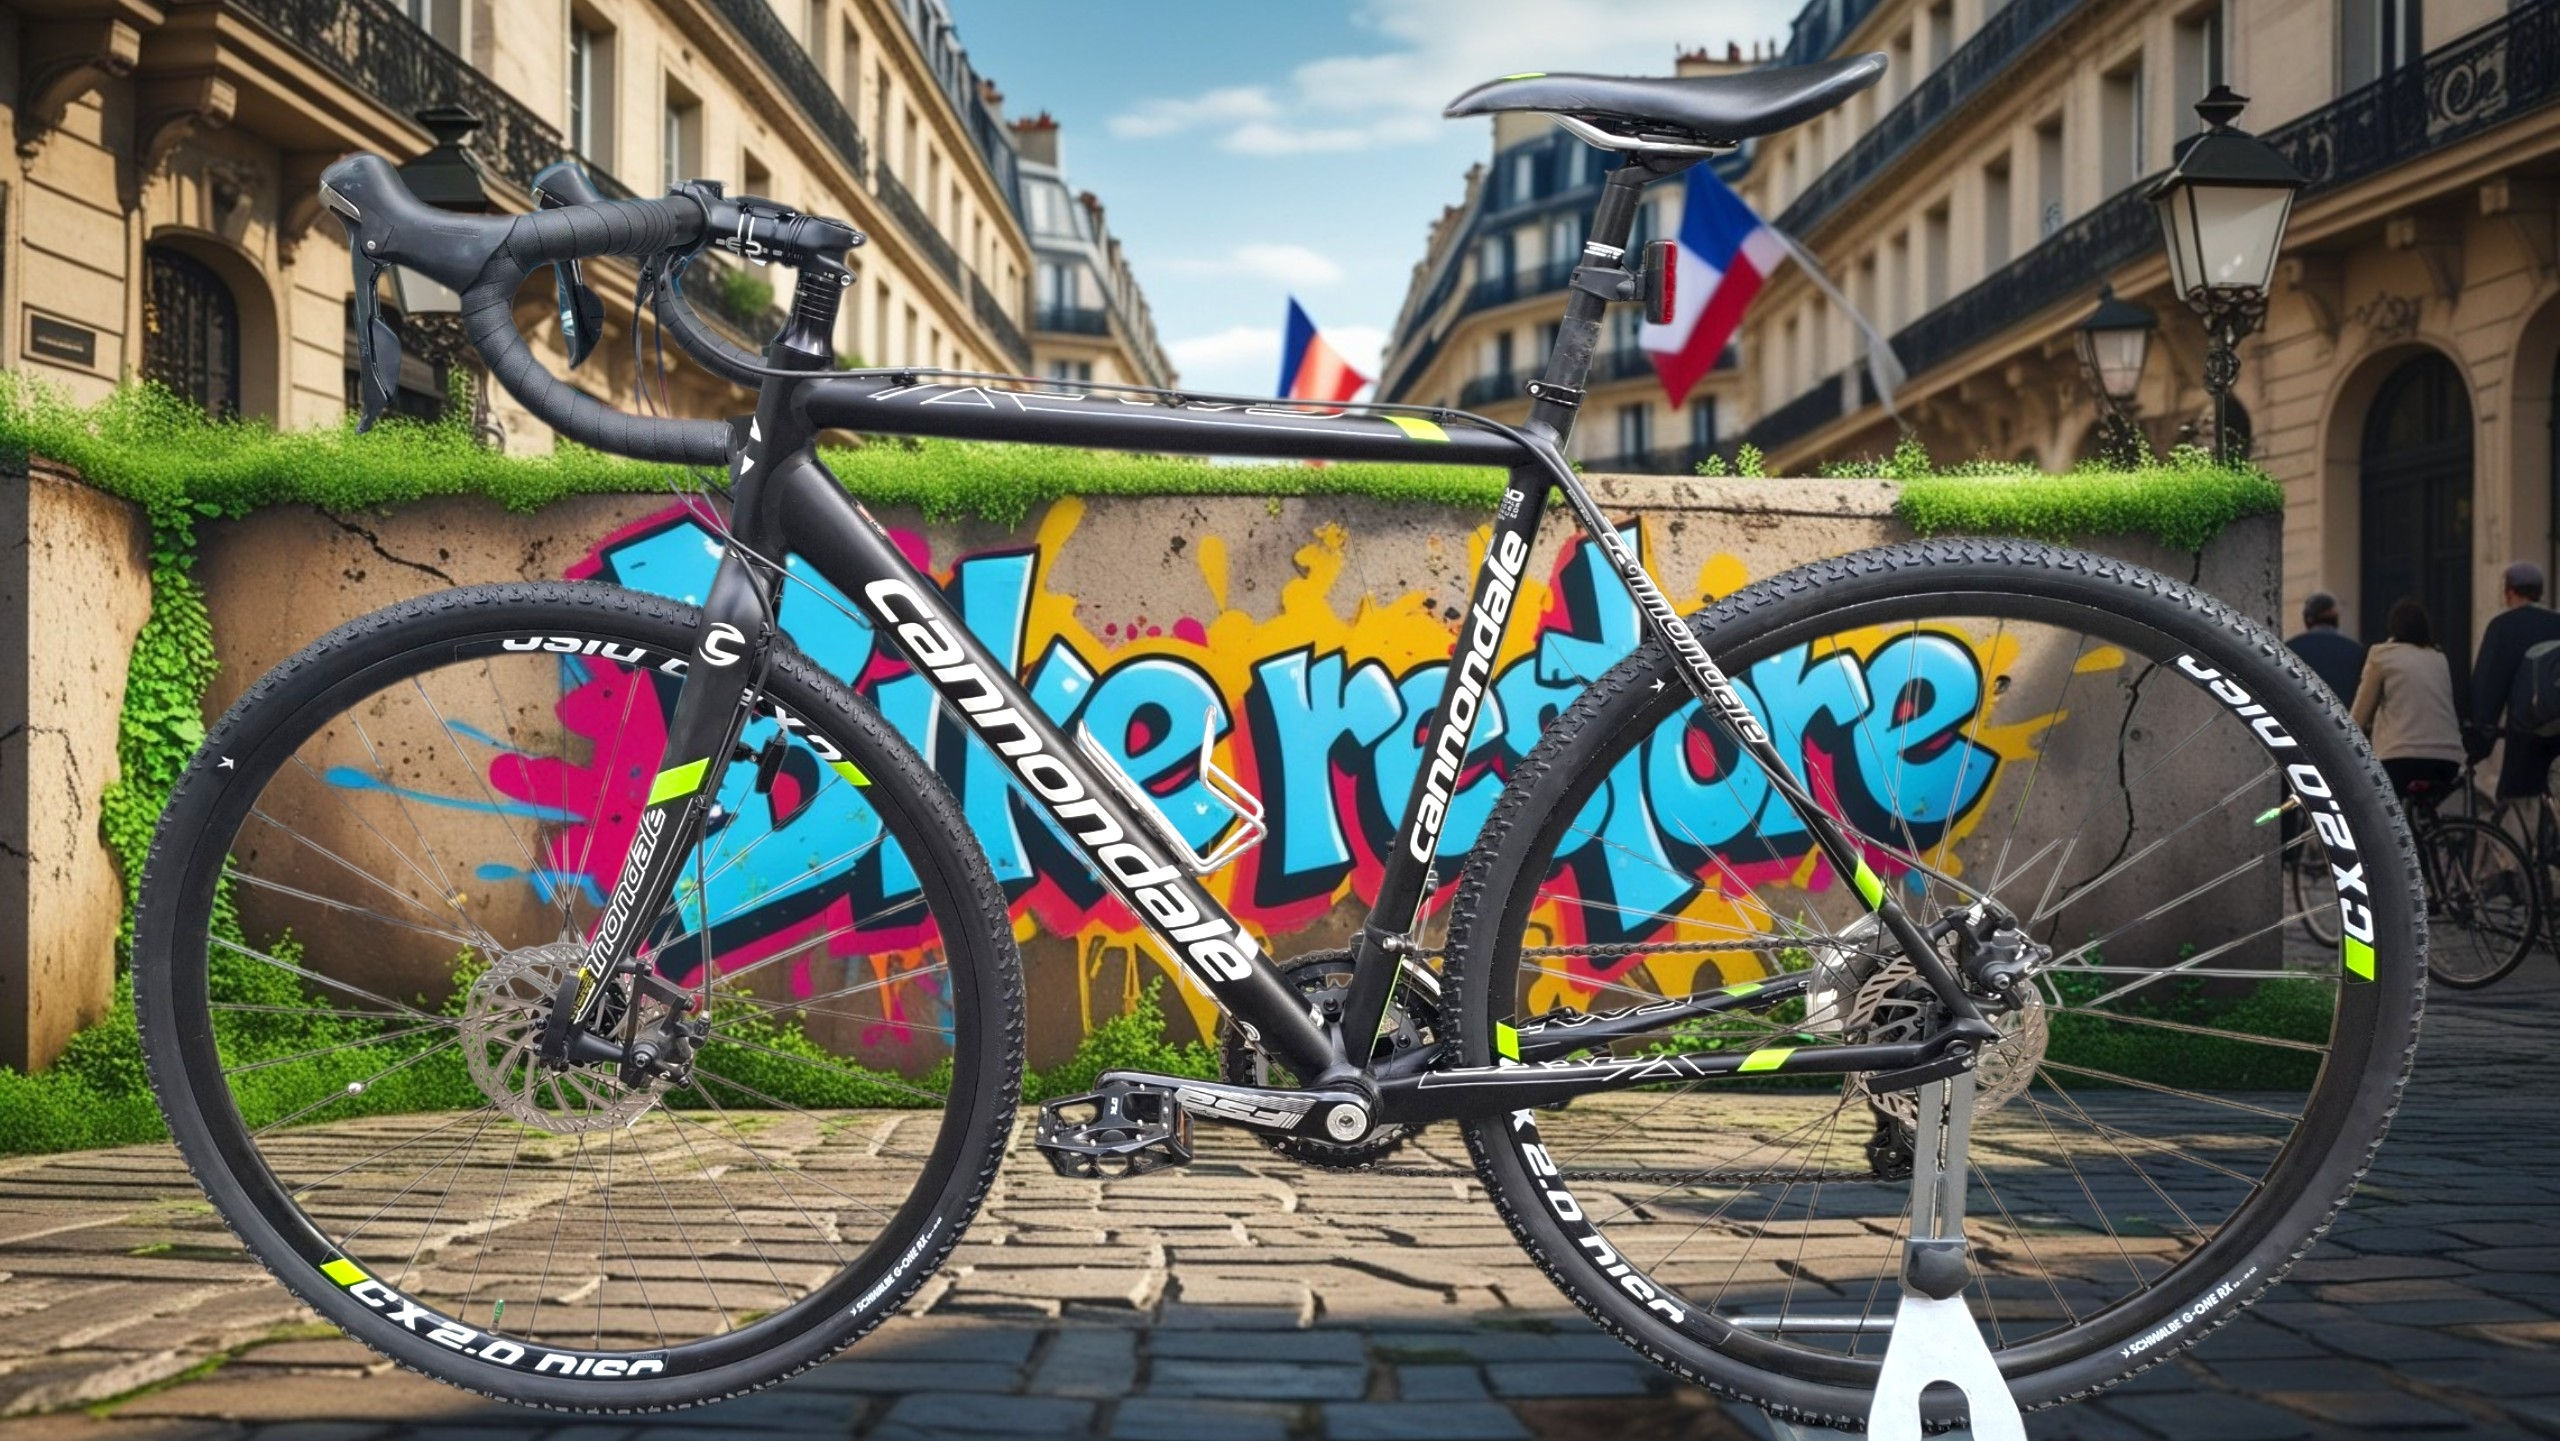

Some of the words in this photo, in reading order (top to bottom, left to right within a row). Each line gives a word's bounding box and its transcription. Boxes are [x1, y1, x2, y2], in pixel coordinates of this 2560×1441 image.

[1410, 530, 1528, 863] cannondale
[865, 579, 1259, 984] cannondale
[2287, 764, 2357, 851] 2.0
[579, 807, 667, 990] nnondale
[2331, 862, 2374, 943] CX
[1521, 1143, 1583, 1221] 2.0
[350, 1279, 428, 1331] CX
[426, 1321, 526, 1366] 2.0
[2129, 1318, 2184, 1355] SCHWALBE
[2182, 1293, 2219, 1323] G-ONE
[2216, 1281, 2234, 1299] RX
